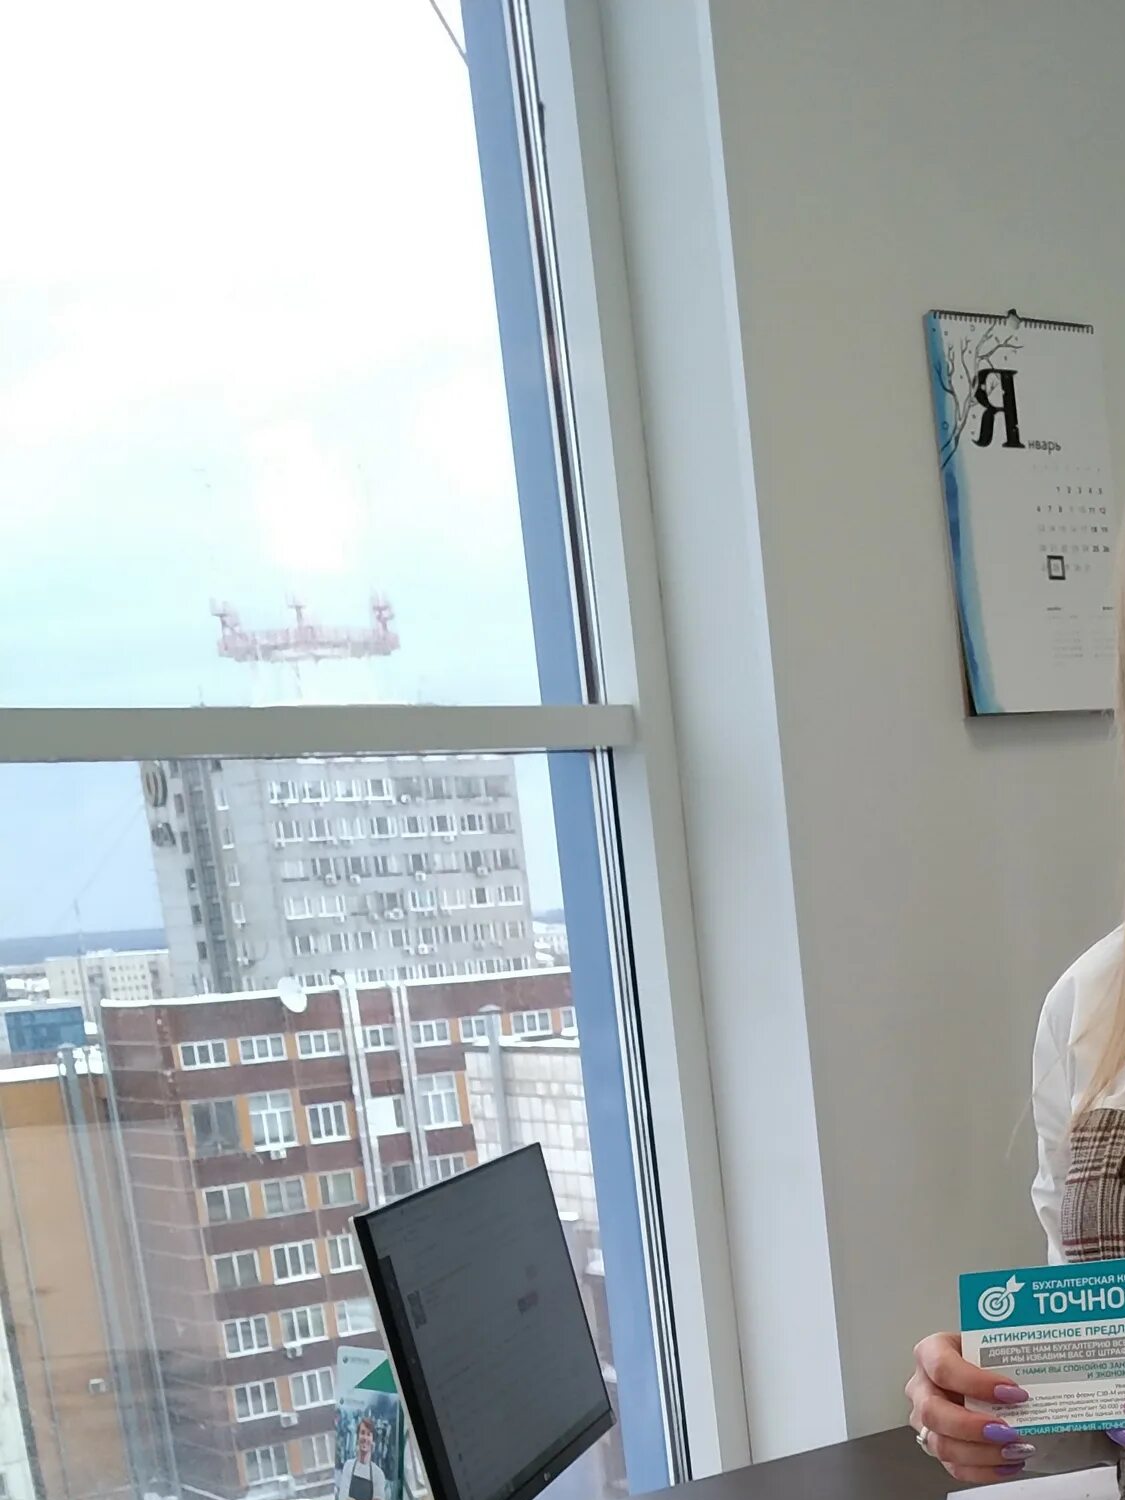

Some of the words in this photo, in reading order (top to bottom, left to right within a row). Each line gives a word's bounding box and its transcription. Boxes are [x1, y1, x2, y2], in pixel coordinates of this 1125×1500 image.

[1032, 1275, 1114, 1290] БУХГАЛТЕРСКАЯ
[981, 1327, 1082, 1345] АНТИКРИЗИСНОЕ
[988, 1346, 1029, 1356] ДОВЕРЬТЕ
[1052, 1339, 1110, 1351] БУХГАЛТЕРИЮ
[1026, 1351, 1065, 1361] ИЗБАВИМ
[1022, 1367, 1045, 1375] НАМИ
[1063, 1360, 1106, 1372] СПОКОЙНО
